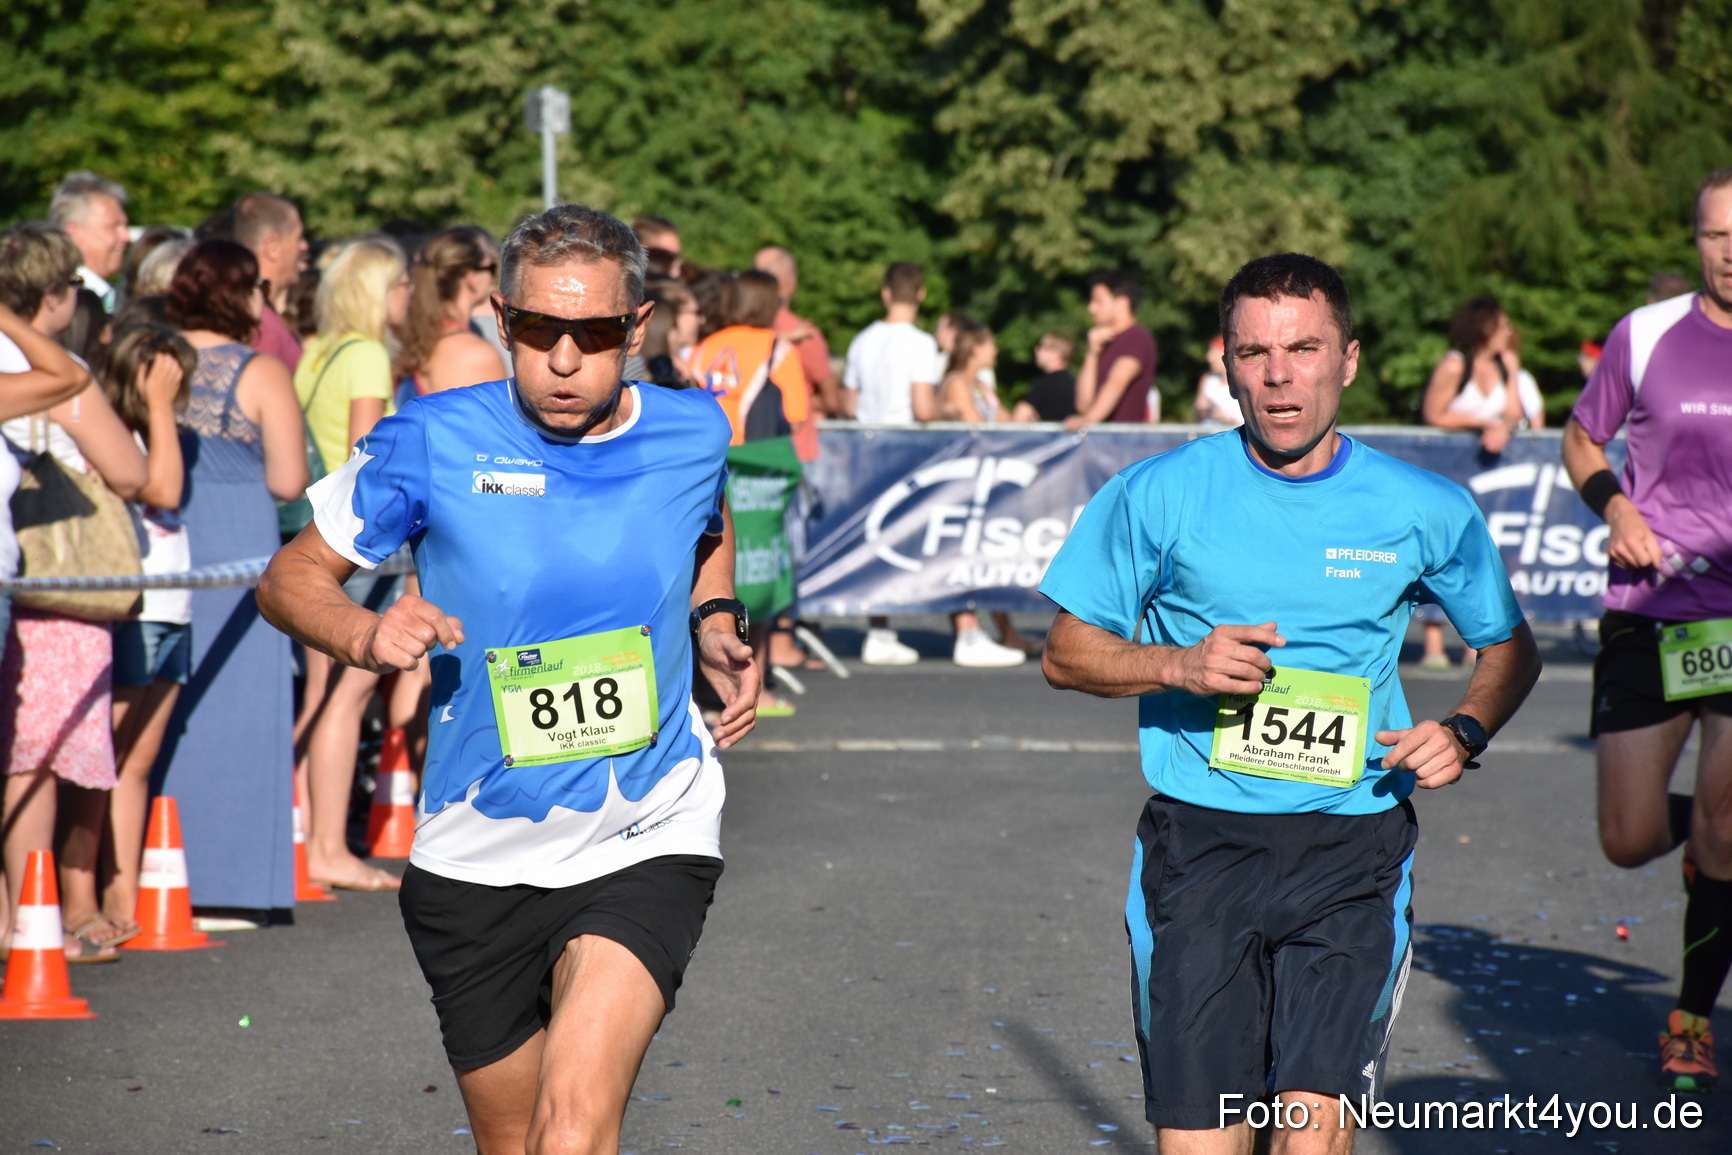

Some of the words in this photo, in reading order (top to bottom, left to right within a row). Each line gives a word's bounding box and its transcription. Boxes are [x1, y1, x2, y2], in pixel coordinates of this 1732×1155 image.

[1680, 401, 1707, 415] WIR
[504, 484, 545, 498] classic
[921, 503, 1086, 559] Fisc
[1486, 511, 1612, 567] Fisc
[1338, 548, 1398, 564] PFLEIDERER
[947, 562, 1048, 588] AUTO
[1325, 566, 1362, 579] Frank
[509, 658, 565, 678] firmenlauf
[572, 662, 603, 677] 2018
[1681, 644, 1732, 677] 680
[1263, 683, 1292, 695] nlauf
[529, 677, 624, 730] 818
[1294, 695, 1322, 707] 2018
[547, 729, 577, 743] Vogt
[580, 724, 616, 737] Klaus
[1236, 703, 1347, 755] 1544
[560, 743, 575, 751] IKK
[577, 737, 607, 749] classic
[1229, 752, 1266, 766] Pfleiderer
[1267, 759, 1316, 774] Deutschland
[1316, 766, 1341, 776] GmbH
[1243, 744, 1295, 761] Abraham
[1297, 752, 1330, 766] Frank
